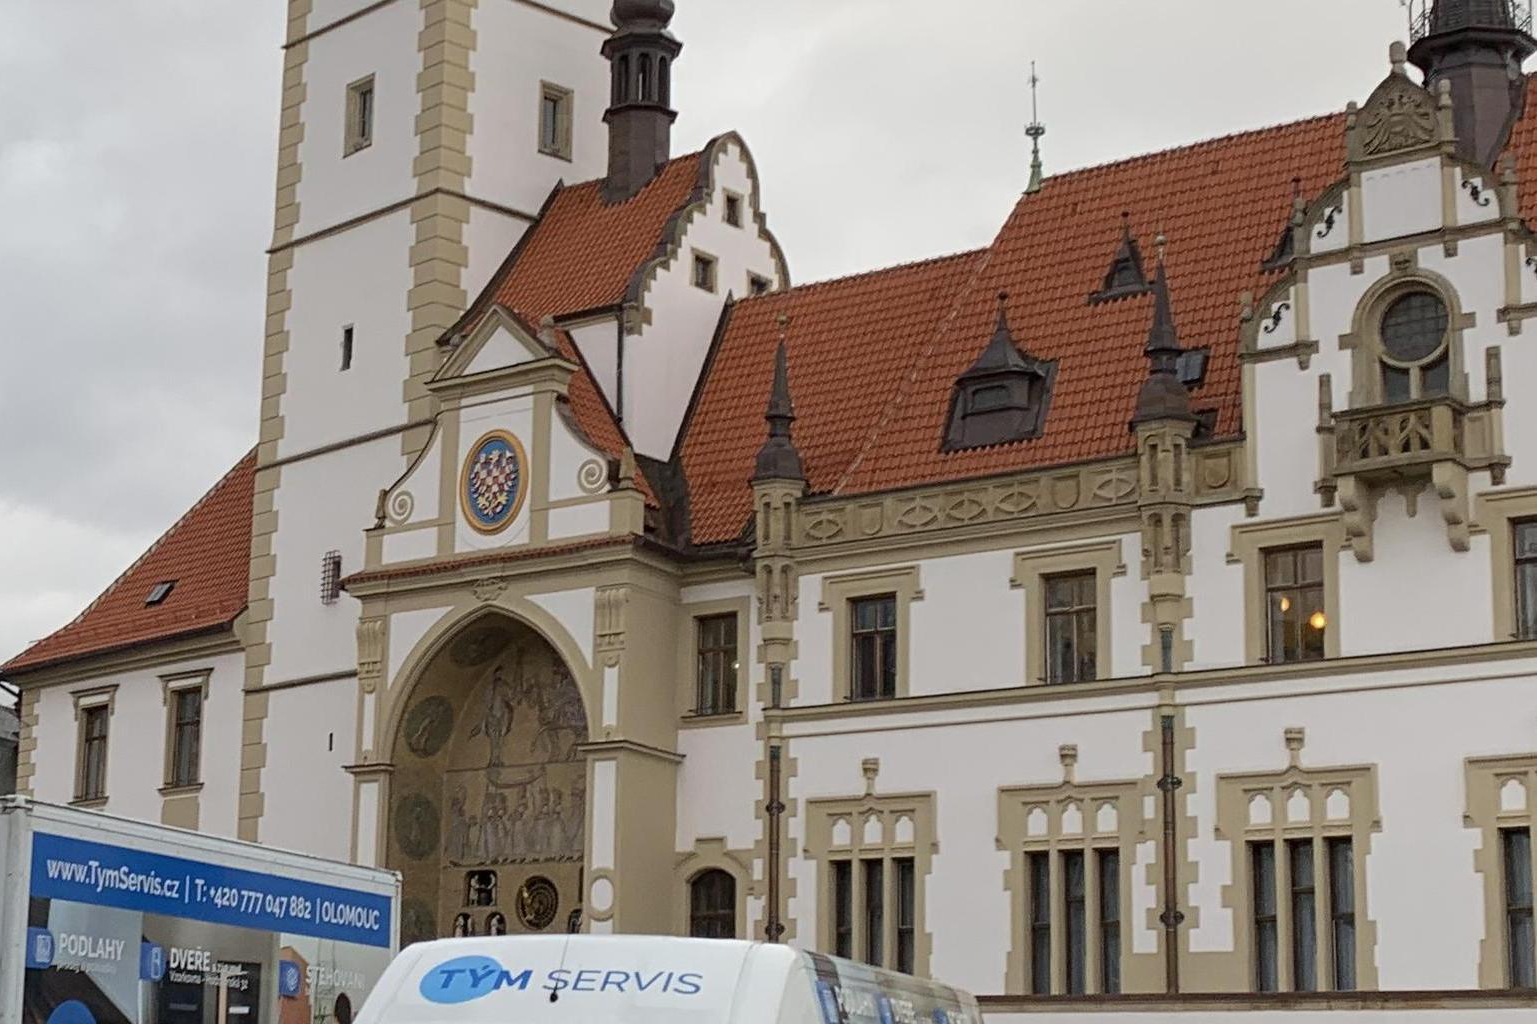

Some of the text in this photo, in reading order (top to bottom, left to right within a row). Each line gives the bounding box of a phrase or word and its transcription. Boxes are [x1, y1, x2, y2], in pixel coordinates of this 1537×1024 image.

[46, 859, 180, 898] www.TymServis.cz
[209, 885, 239, 908] +420
[240, 890, 263, 914] 777
[266, 896, 287, 919] 047
[289, 895, 312, 919] 882
[321, 900, 381, 931] OLOMOUC
[59, 932, 125, 961] PODLAHY
[438, 964, 703, 994] TÝM SERVIS
